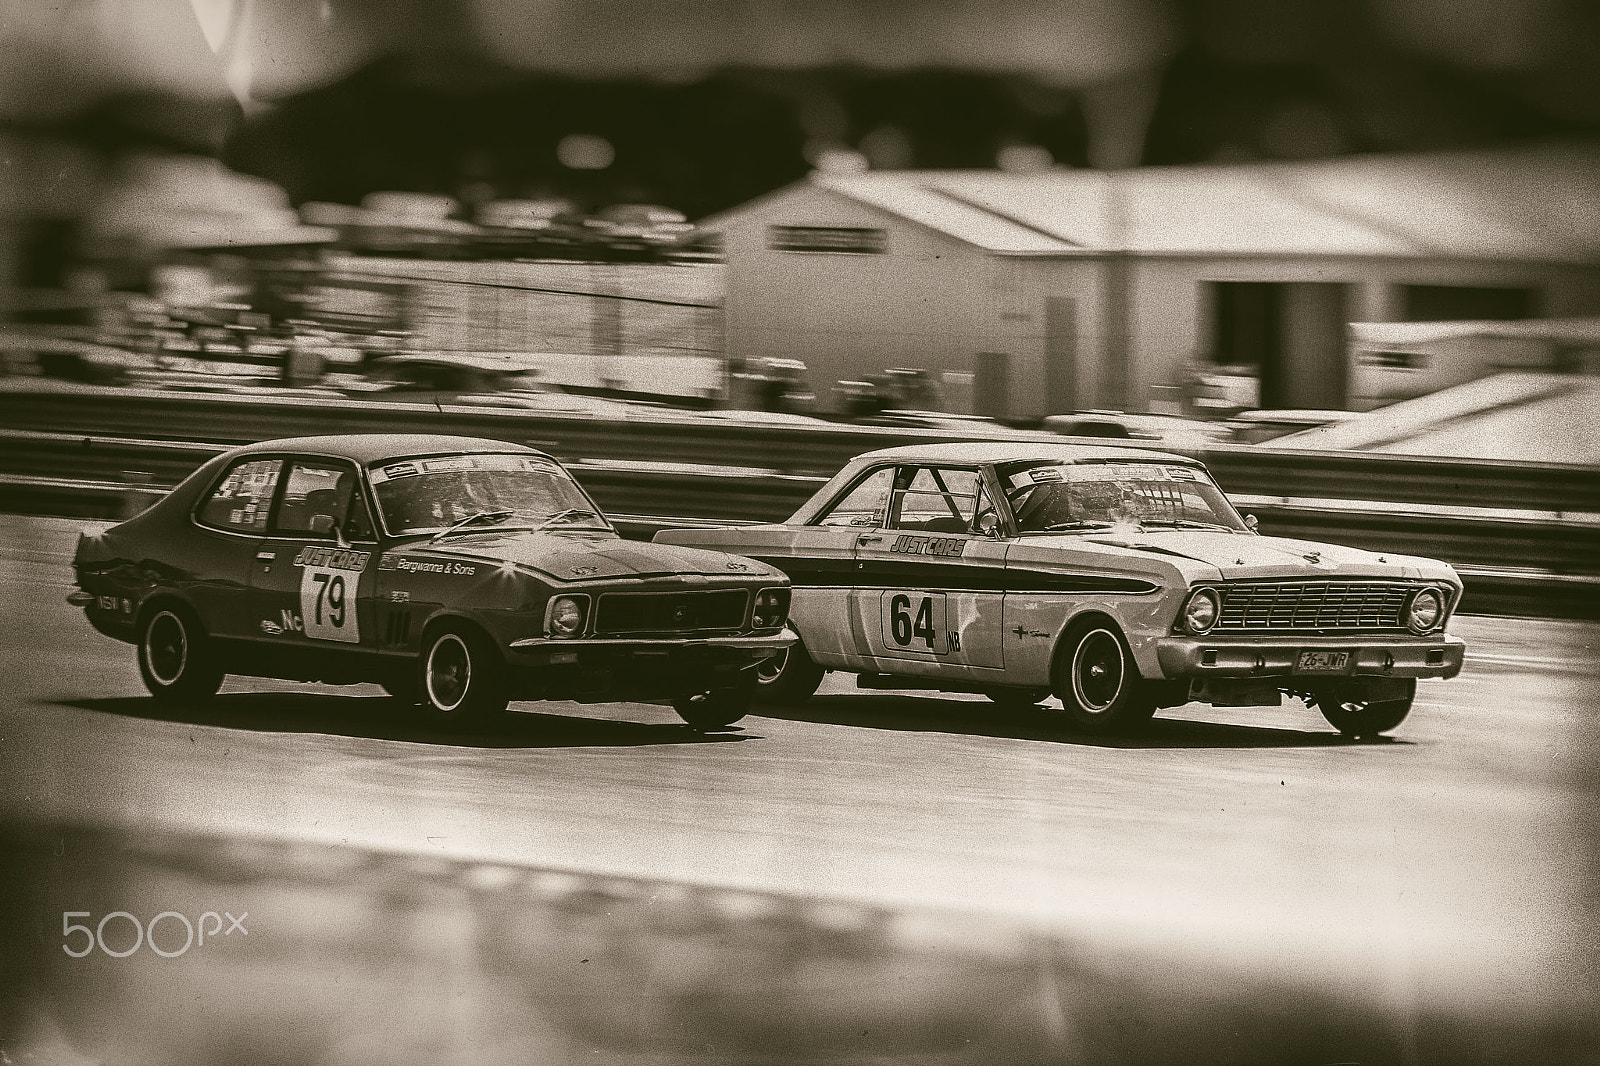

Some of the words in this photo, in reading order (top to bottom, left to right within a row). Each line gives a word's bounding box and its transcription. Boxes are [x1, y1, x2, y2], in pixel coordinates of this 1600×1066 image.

[444, 562, 452, 574] &
[453, 563, 475, 576] Sons
[313, 573, 345, 628] 79
[890, 593, 936, 649] 64
[947, 631, 961, 652] NB
